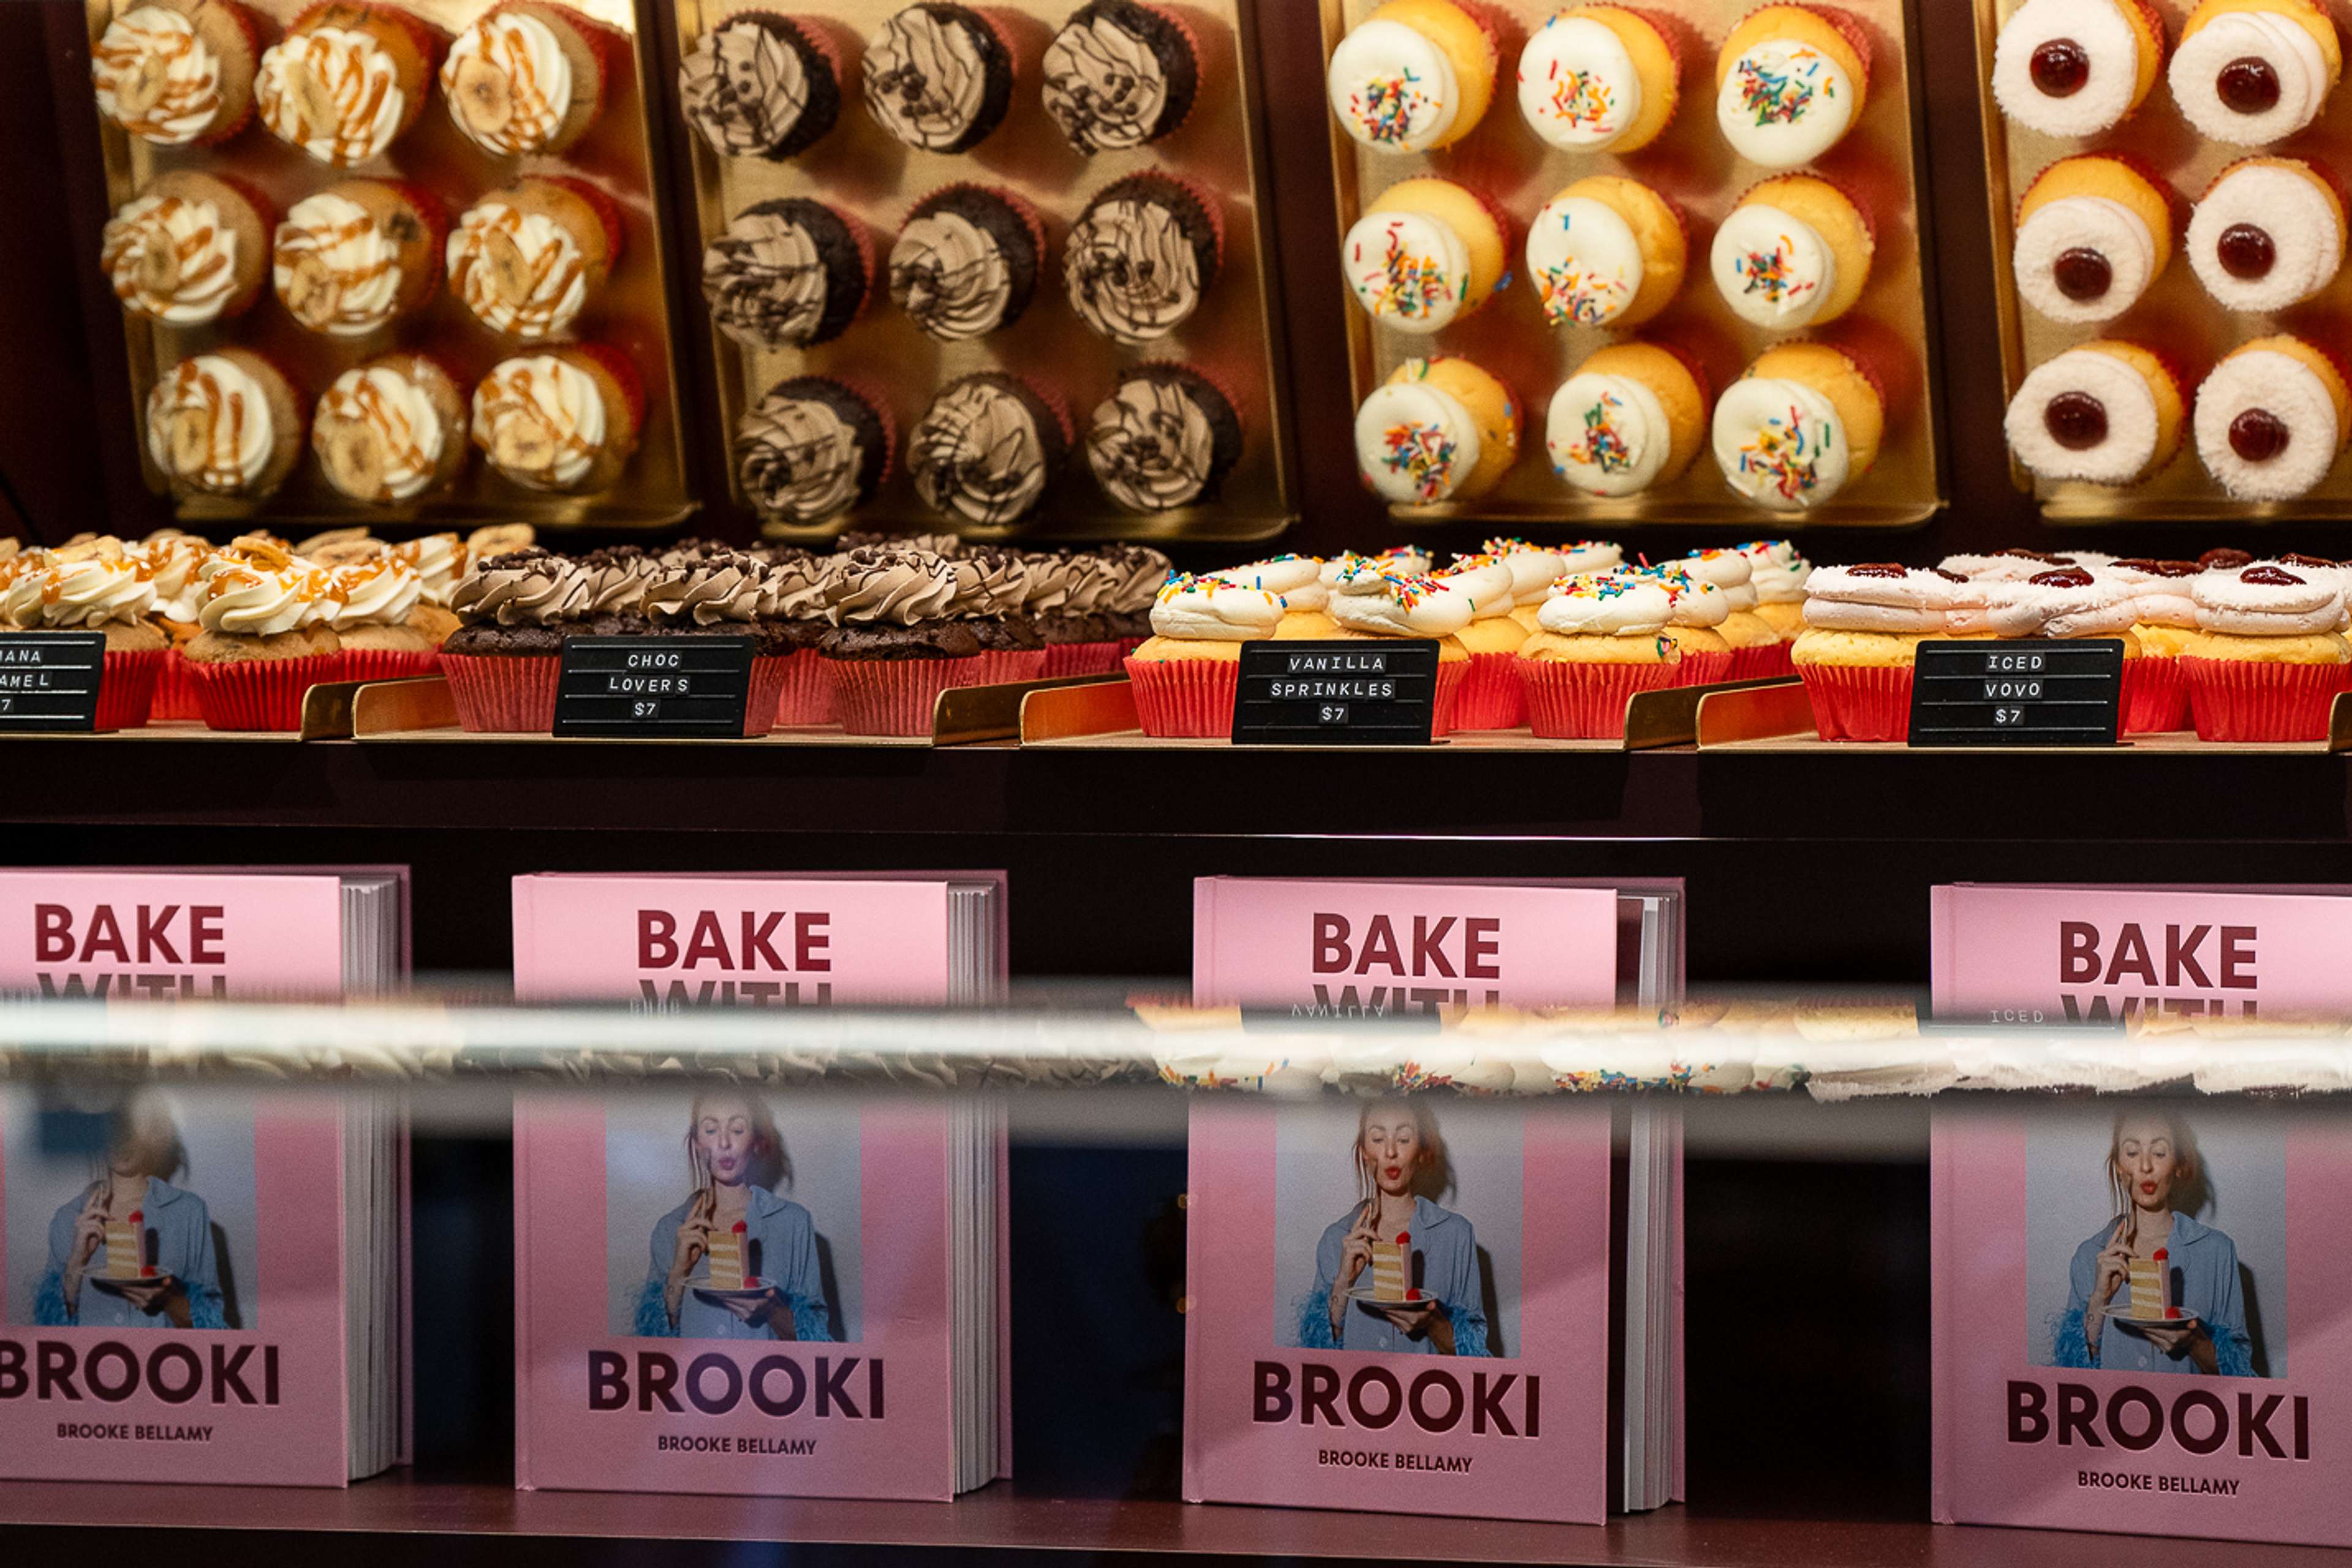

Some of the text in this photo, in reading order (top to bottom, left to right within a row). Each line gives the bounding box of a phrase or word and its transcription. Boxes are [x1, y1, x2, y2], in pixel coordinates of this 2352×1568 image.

[0, 650, 40, 662] ANA
[628, 654, 679, 668] CHOC
[1290, 656, 1383, 671] VANILLA
[1989, 655, 2042, 669] ICED
[610, 677, 688, 692] LOVERS
[1271, 682, 1392, 697] SPRINKLES
[1986, 682, 2040, 697] VOVO
[635, 702, 656, 716] $7
[1322, 706, 1344, 720] $7
[1995, 709, 2021, 723] $7
[36, 904, 225, 964] BAKE
[638, 910, 831, 971] BAKE
[1313, 913, 1499, 979] BAKE
[2061, 921, 2257, 989] BAKE
[588, 1350, 884, 1419] BROOKI
[1254, 1361, 1540, 1437] BROOKI
[2008, 1381, 2309, 1460] BROOKI
[58, 1423, 213, 1441] BROOKE BELLAMY
[659, 1436, 816, 1455] BROOKE BELLAMY
[1319, 1450, 1472, 1472] BROOKE BELLAMY
[2078, 1471, 2239, 1494] BROOKE BELLAMY
